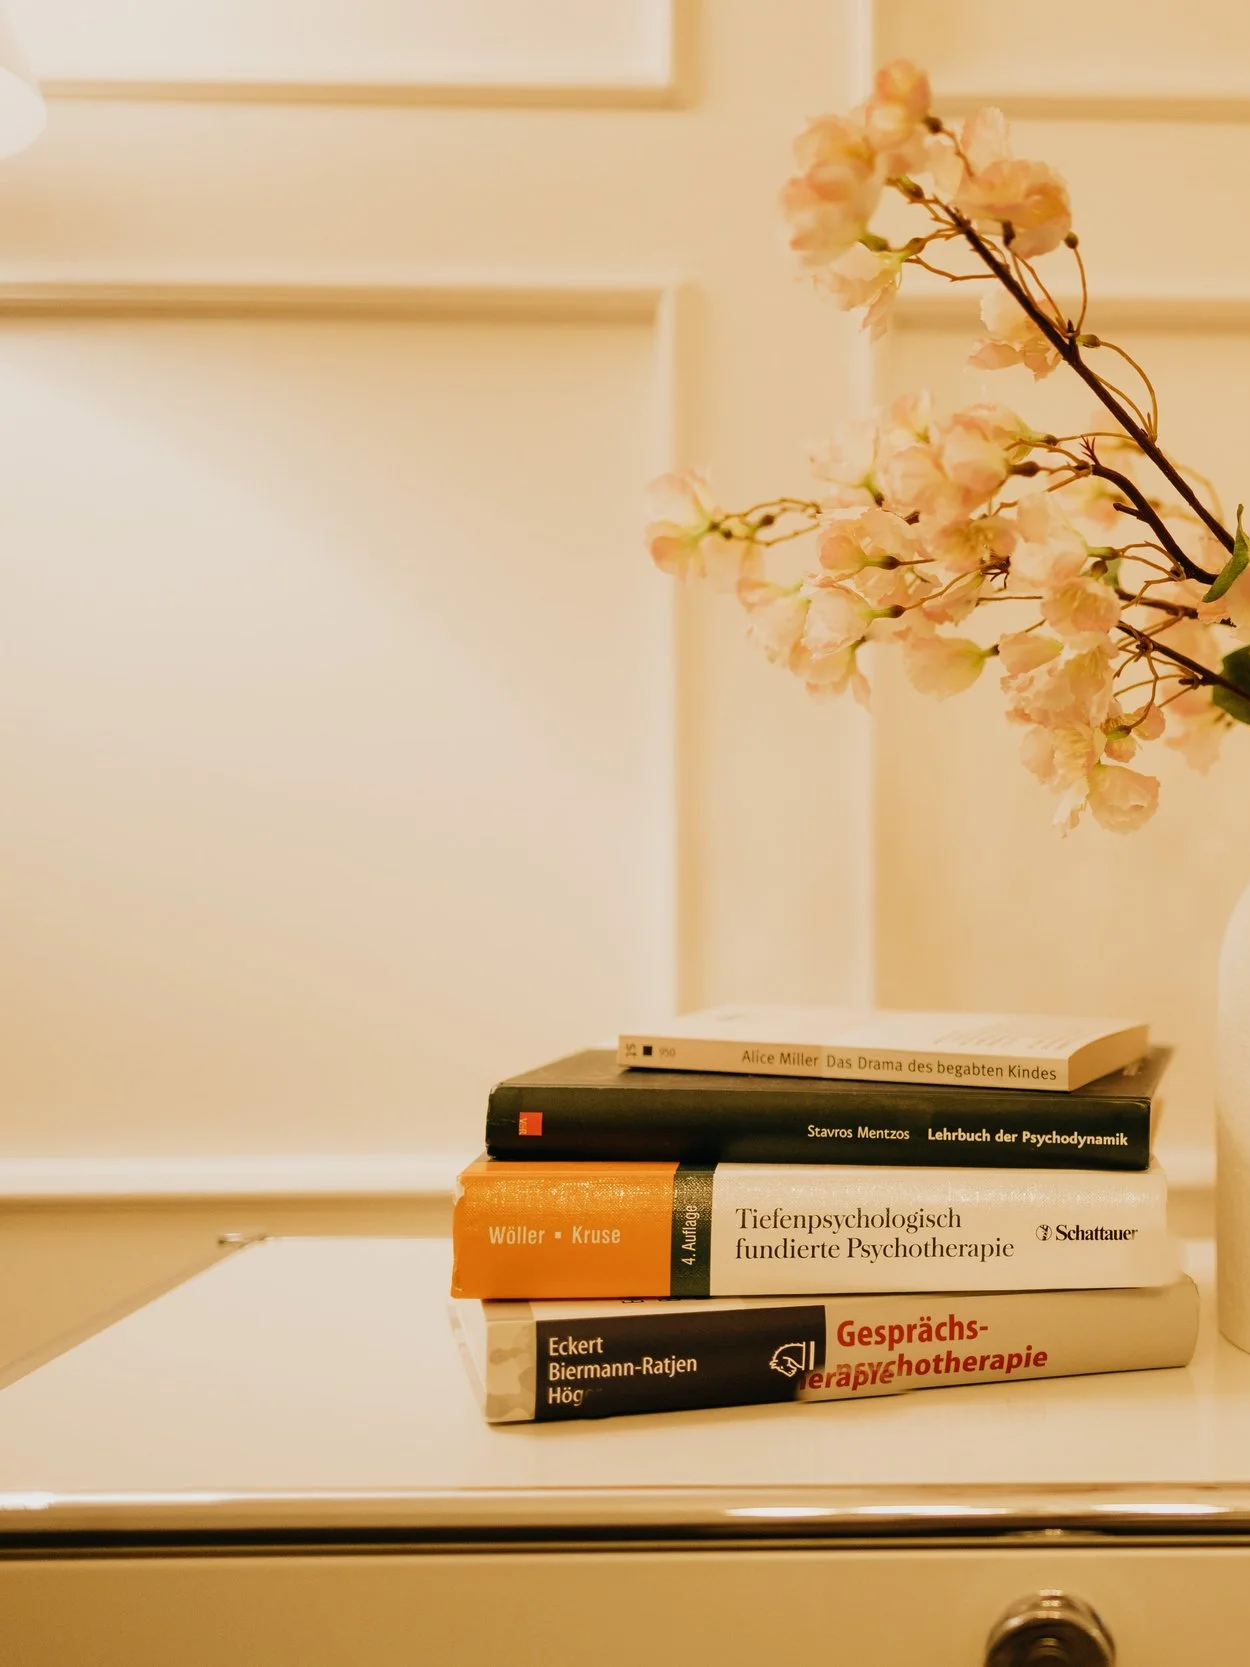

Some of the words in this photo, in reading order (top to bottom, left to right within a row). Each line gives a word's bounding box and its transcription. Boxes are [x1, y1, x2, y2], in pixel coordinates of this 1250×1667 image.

[742, 1050, 775, 1065] Alice
[779, 1052, 819, 1067] Miller
[827, 1055, 852, 1069] Das
[858, 1057, 903, 1072] Drama
[908, 1059, 933, 1074] des
[937, 1061, 1004, 1078] begabten
[1008, 1065, 1057, 1081] Kindes
[807, 1124, 853, 1139] Stavros
[857, 1126, 911, 1141] Mentzos
[927, 1128, 991, 1143] Lehrbuch
[995, 1129, 1018, 1144] der
[1022, 1130, 1129, 1149] Psychodynamik
[681, 1204, 700, 1252] Auflage
[735, 1207, 962, 1234] Tiefenpsychologisch
[1055, 1223, 1139, 1242] Schattauer
[488, 1225, 546, 1245] Wöller
[572, 1226, 621, 1244] Kruse
[681, 1253, 696, 1266] 4.
[735, 1236, 841, 1260] fundierte
[846, 1236, 1015, 1264] Psychotherapie
[836, 1313, 989, 1351] Gesprächs-
[548, 1336, 604, 1356] Eckert
[548, 1354, 698, 1382] Biermann-Ratjen
